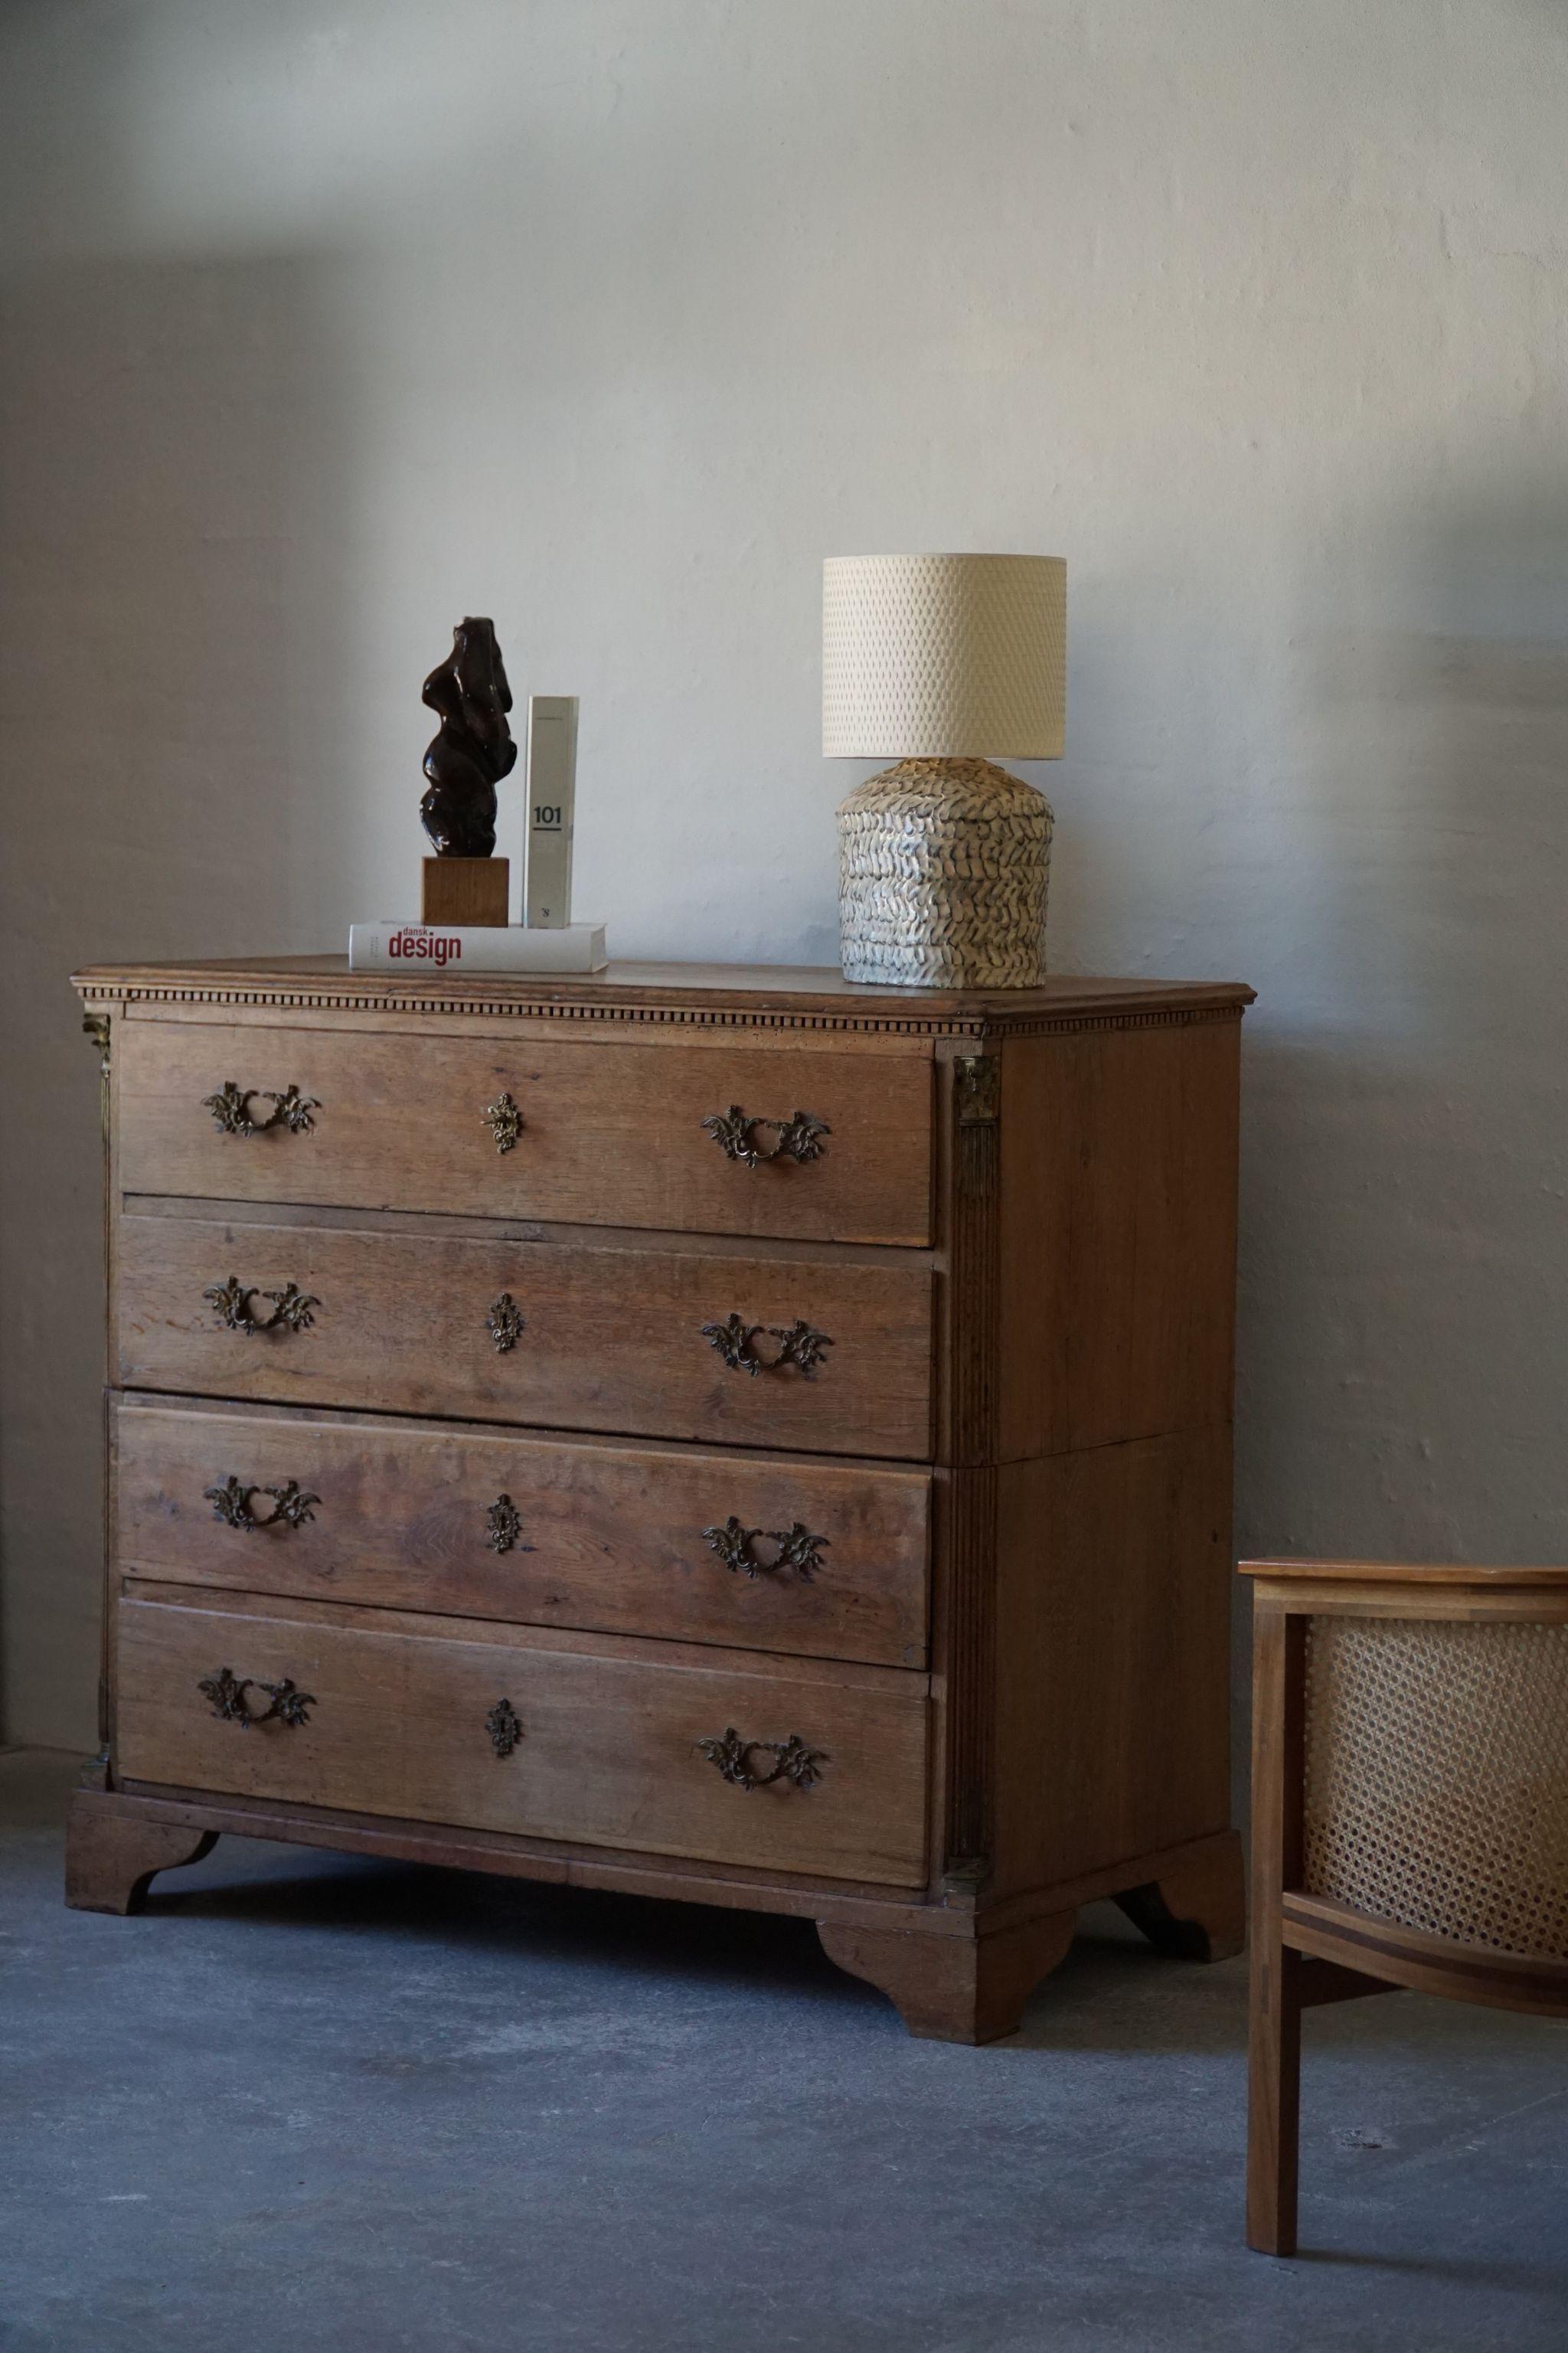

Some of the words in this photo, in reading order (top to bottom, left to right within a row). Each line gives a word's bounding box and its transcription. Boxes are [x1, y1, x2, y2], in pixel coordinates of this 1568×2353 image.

[534, 806, 560, 823] 101
[403, 926, 428, 936] dansk
[389, 931, 461, 966] design
